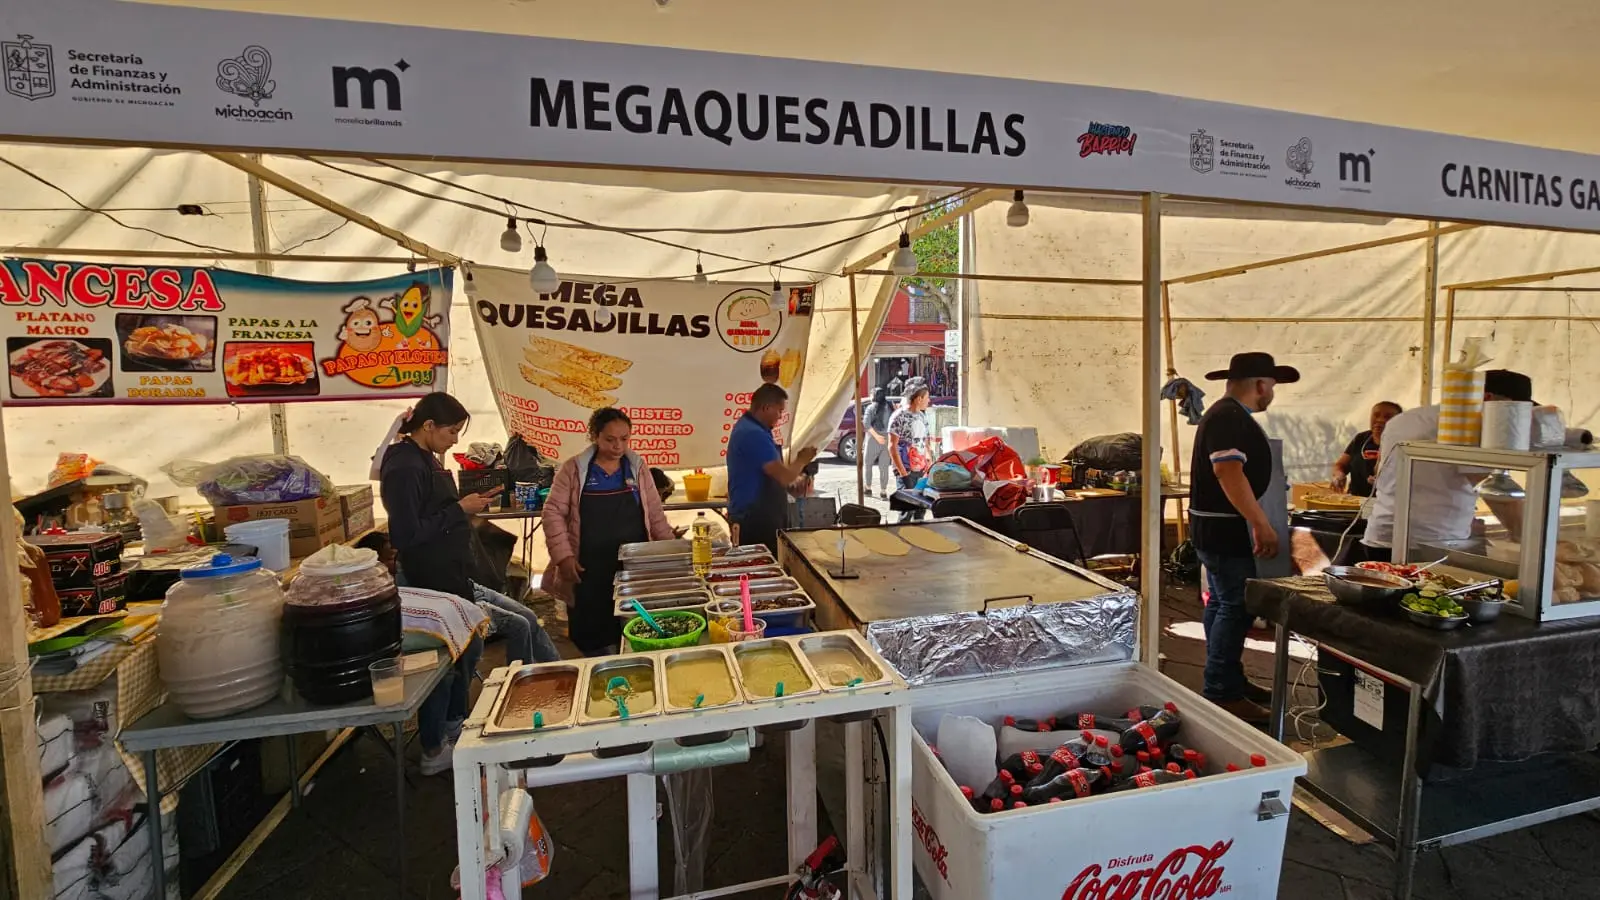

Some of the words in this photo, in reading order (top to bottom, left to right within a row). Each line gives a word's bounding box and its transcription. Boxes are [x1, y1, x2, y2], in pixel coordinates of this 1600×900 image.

[68, 49, 143, 65] Secretaría
[69, 64, 89, 76] de
[92, 65, 156, 80] Finanzas
[159, 71, 168, 82] y
[70, 78, 181, 95] Administración
[215, 104, 293, 120] Michoacán
[530, 77, 1026, 157] MEGAQUESADILLAS
[1230, 150, 1260, 160] Finanzas
[1441, 163, 1563, 207] CARNITAS
[539, 281, 644, 309] MEGA
[15, 311, 96, 323] PLATANO
[228, 317, 280, 328] PAPAS
[285, 319, 296, 329] A
[299, 319, 319, 329] LA
[476, 299, 711, 339] QUESADILLAS
[27, 325, 89, 336] MACHO
[231, 329, 313, 340] FRANCESA
[323, 351, 378, 375] PAPAS
[379, 350, 395, 366] Y
[139, 376, 194, 386] PAPAS
[372, 366, 434, 387] Angy
[127, 387, 207, 398] DORADAS
[630, 407, 682, 421] BISTEC
[629, 438, 677, 451] RAJAS
[1107, 854, 1154, 869] Disfruta
